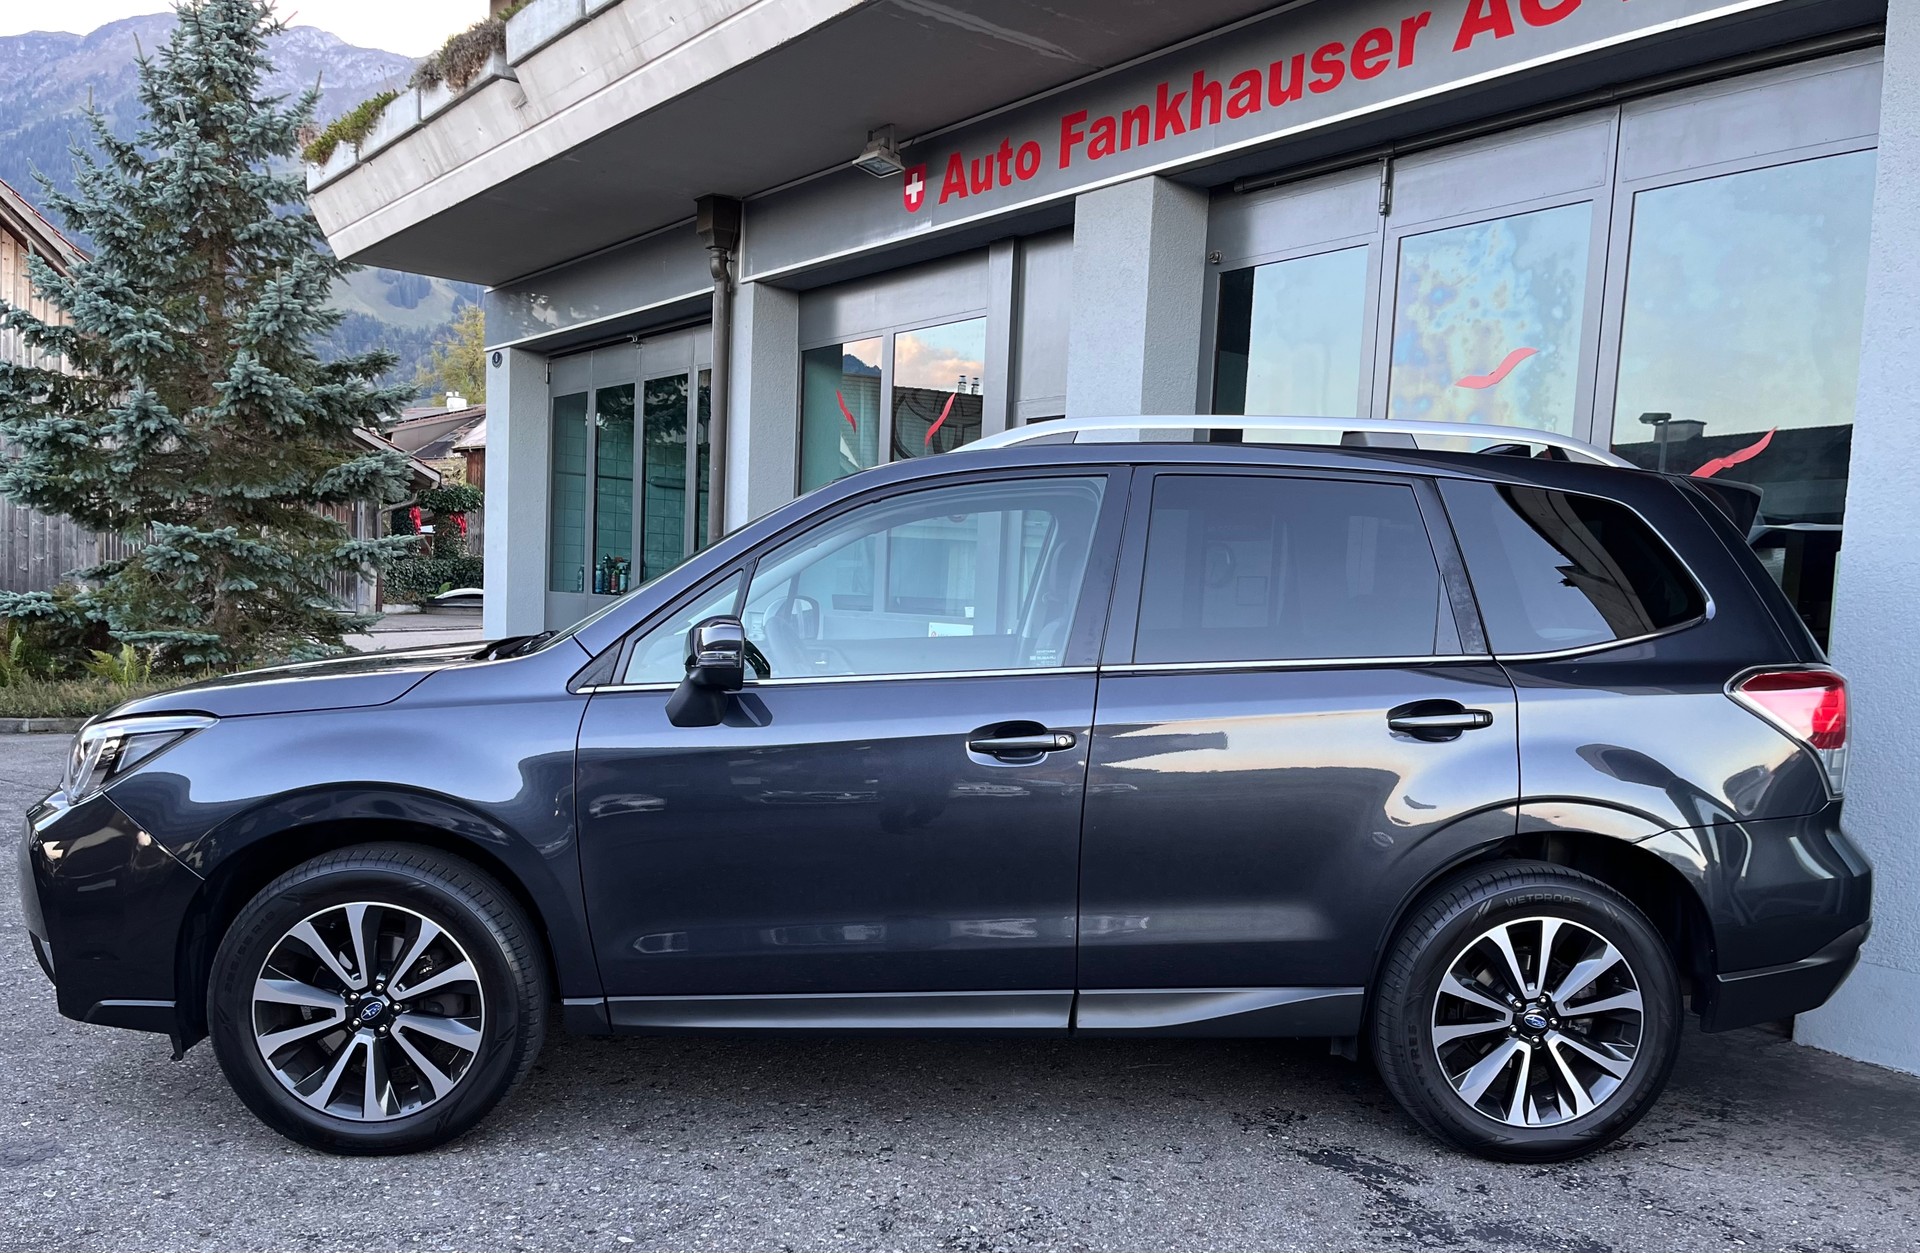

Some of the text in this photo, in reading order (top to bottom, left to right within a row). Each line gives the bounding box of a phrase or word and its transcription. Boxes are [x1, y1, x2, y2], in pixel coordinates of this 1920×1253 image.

[938, 136, 1041, 205] Auto
[1059, 10, 1432, 170] Fankhauser
[1505, 893, 1581, 907] WETPROOF
